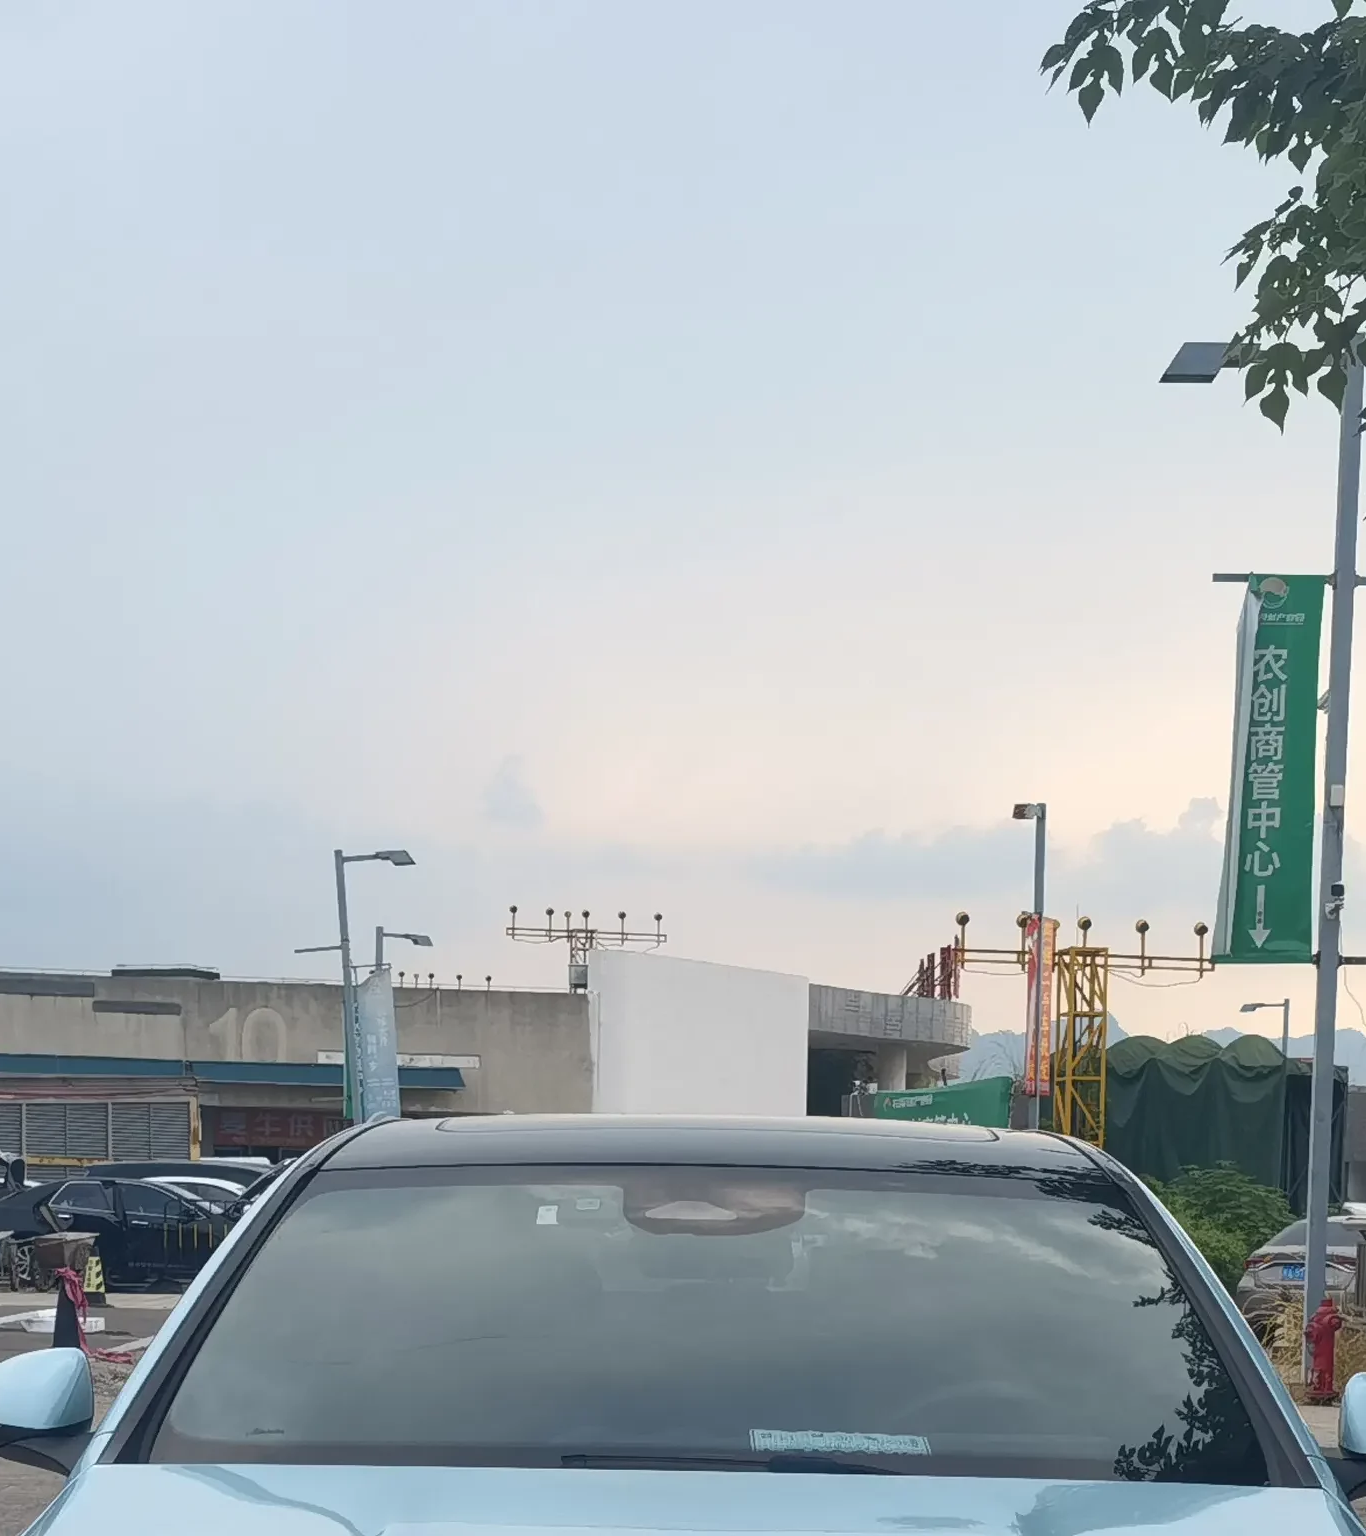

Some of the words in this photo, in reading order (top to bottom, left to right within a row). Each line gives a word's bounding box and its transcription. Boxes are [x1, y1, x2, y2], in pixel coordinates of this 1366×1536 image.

[1244, 644, 1288, 877] 农创商管中心
[209, 1007, 287, 1062] 10
